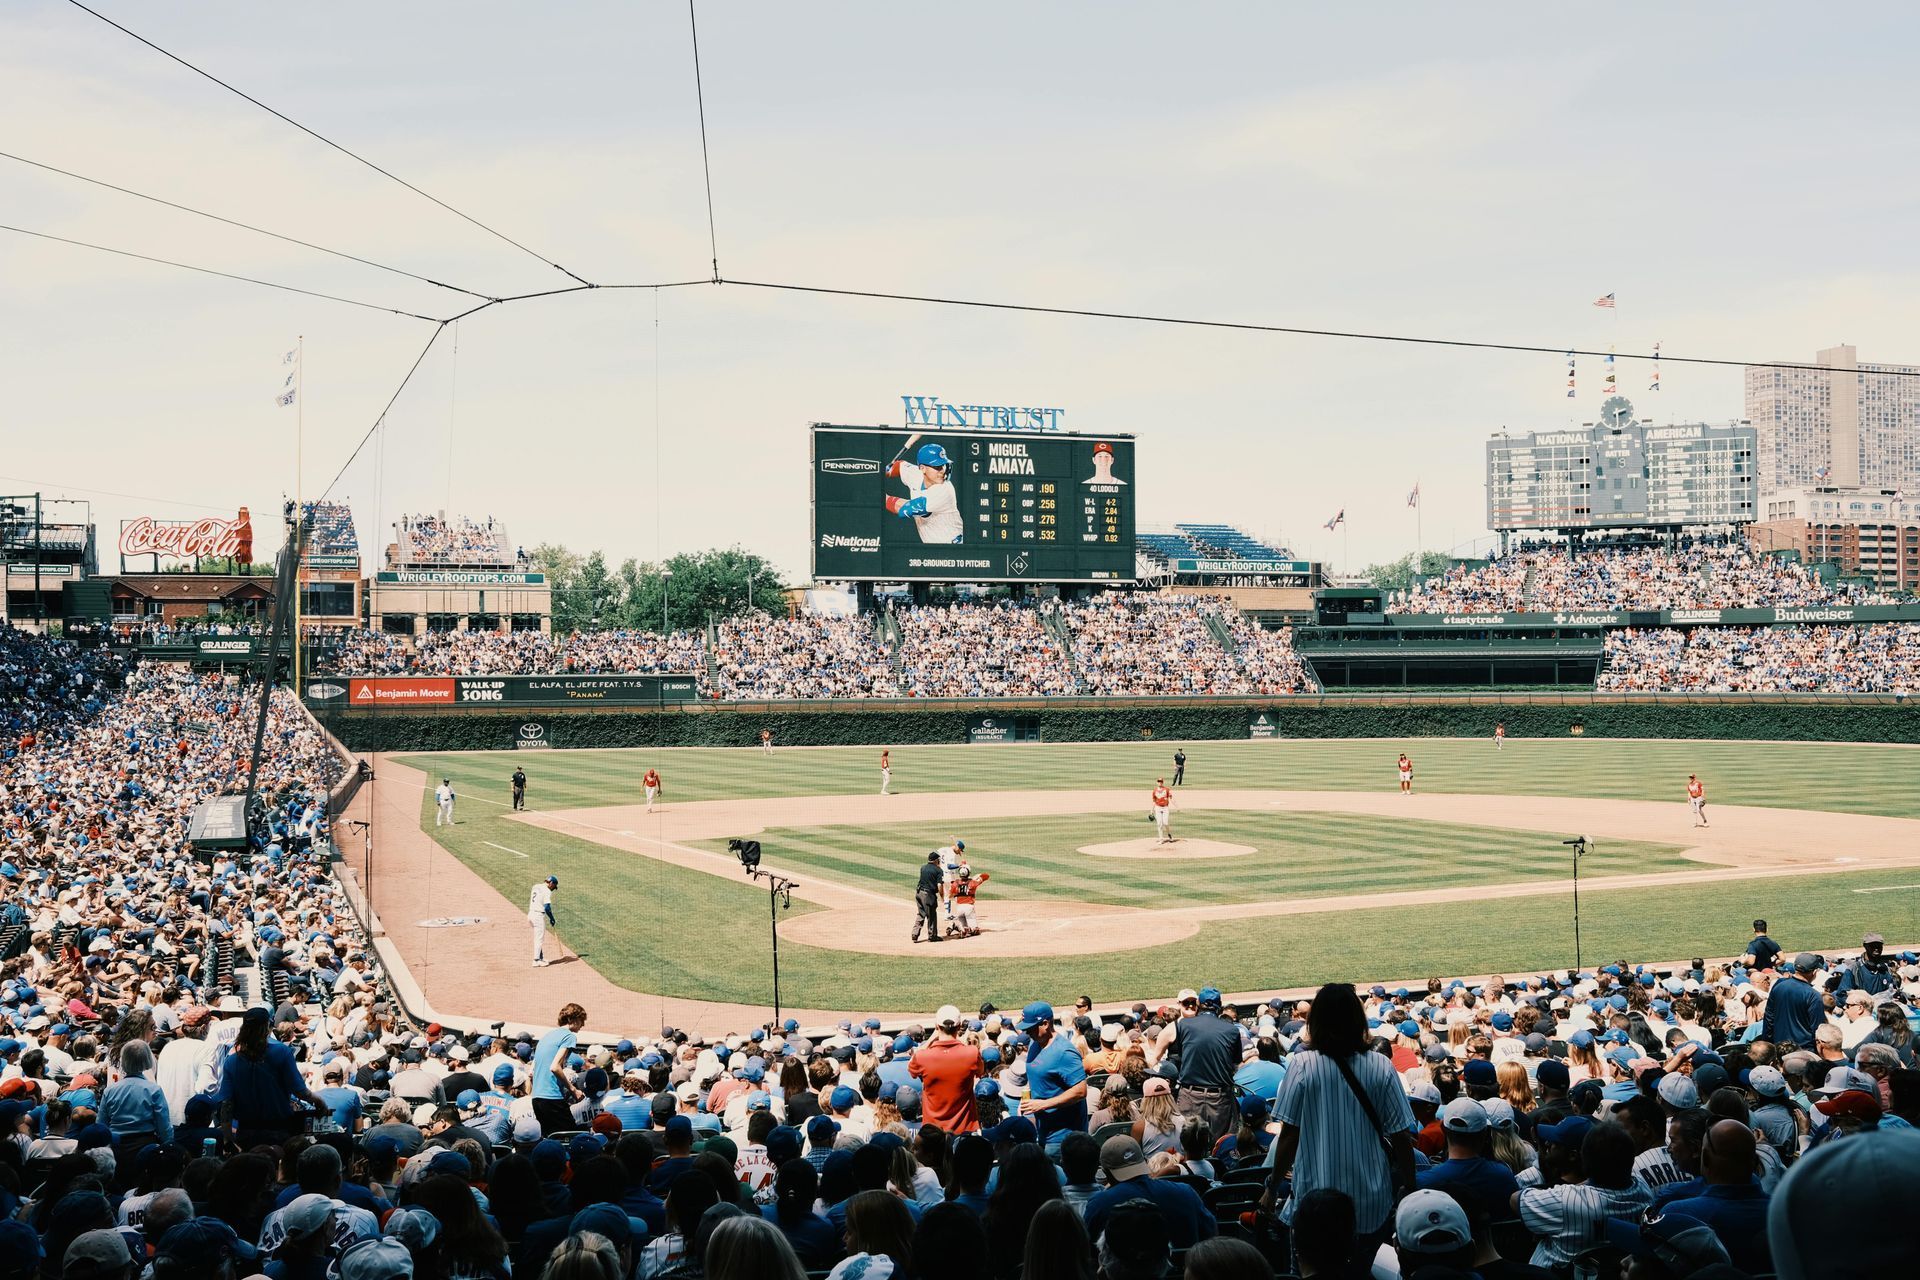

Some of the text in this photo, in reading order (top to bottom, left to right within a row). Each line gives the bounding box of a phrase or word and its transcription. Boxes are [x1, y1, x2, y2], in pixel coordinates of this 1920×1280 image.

[901, 396, 1064, 430] WINTRUST
[1646, 427, 1701, 439] AMERICAN
[1536, 433, 1590, 445] NATIONAL
[971, 442, 980, 456] 9
[989, 443, 1029, 457] MIGUEL
[824, 462, 877, 470] PENNINGTON
[972, 462, 979, 472] C
[989, 458, 1035, 475] AMAYA
[998, 483, 1009, 492] 116
[1039, 483, 1055, 493] .190
[1098, 485, 1119, 493] LODOLO
[1001, 498, 1007, 507] 2
[1039, 499, 1055, 509] .256
[1106, 498, 1116, 506] 4-2
[999, 514, 1008, 523] 13
[1039, 515, 1055, 524] .276
[119, 517, 248, 558] Coca-Cola
[1001, 530, 1007, 539] 9
[1039, 530, 1055, 540] .532
[909, 559, 955, 567] 3RD-GROUNDED
[1568, 614, 1617, 623] Advocate
[1670, 610, 1721, 618] GRAINGER
[1774, 608, 1853, 620] Budweiser
[1451, 615, 1504, 624] tastytrade
[200, 641, 251, 649] GRAINGER
[461, 681, 505, 689] WALK-UP
[376, 689, 449, 699] Benjamin Moore
[462, 690, 503, 700] SONG
[971, 727, 1008, 735] Gallagher
[747, 1155, 759, 1165] LA
